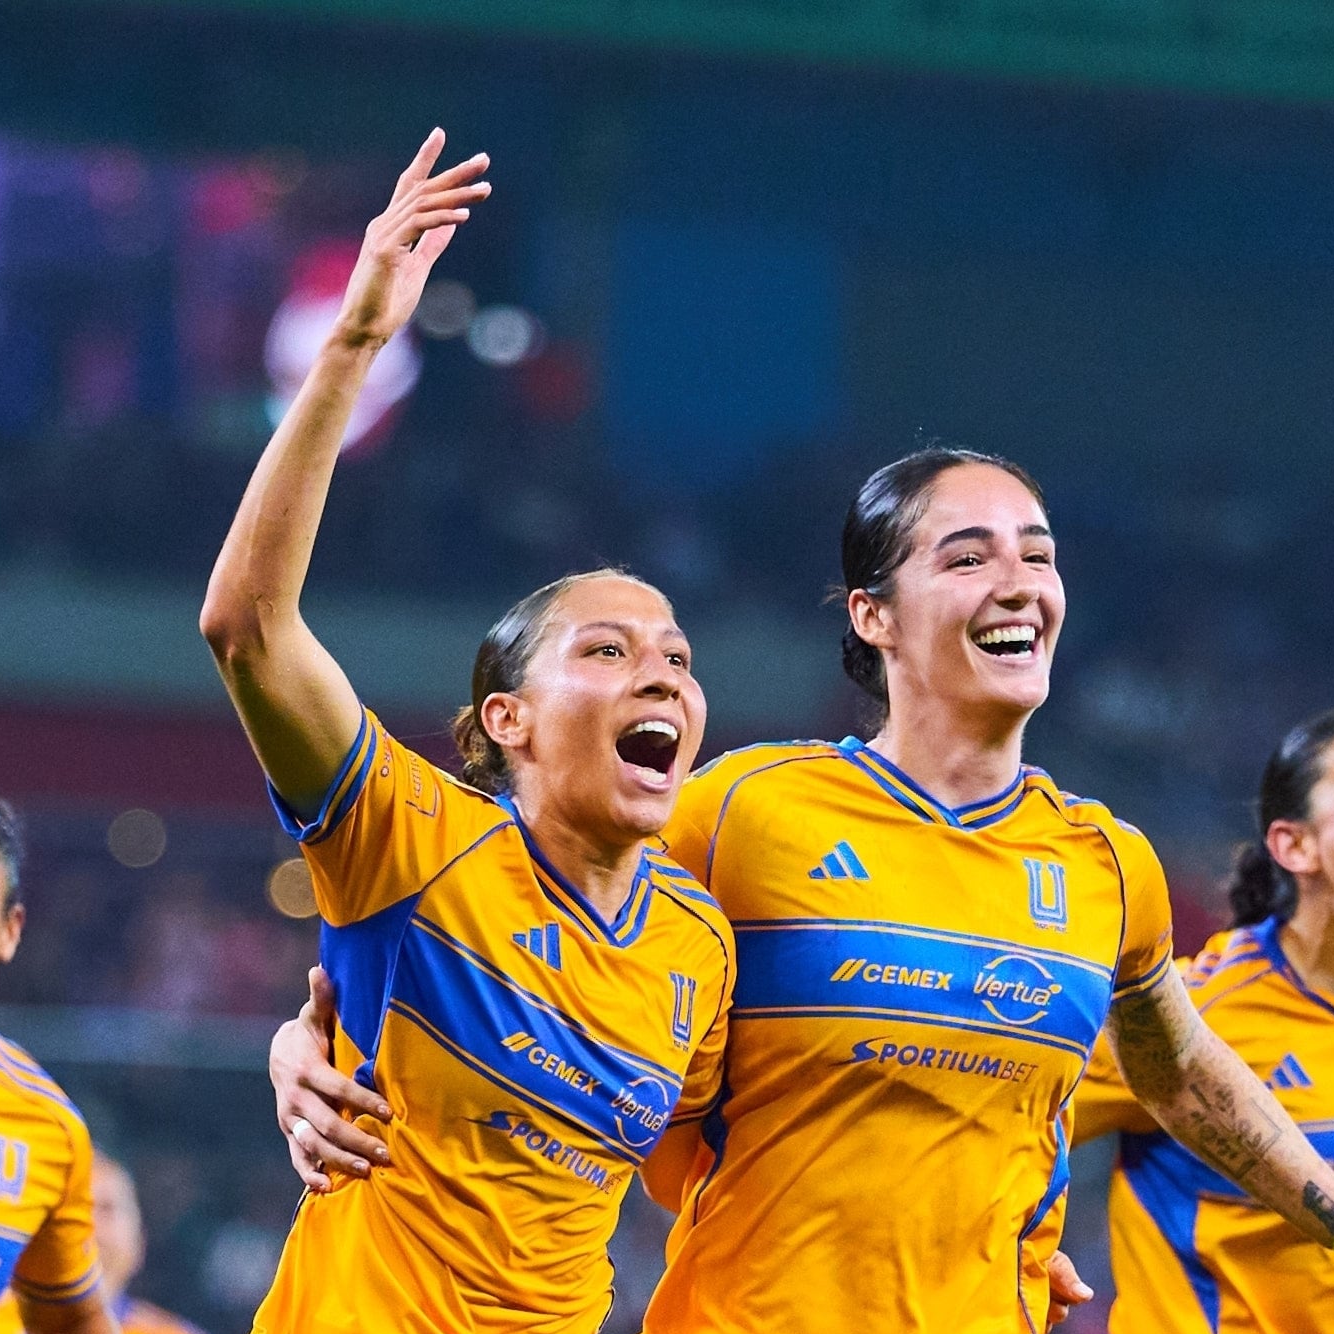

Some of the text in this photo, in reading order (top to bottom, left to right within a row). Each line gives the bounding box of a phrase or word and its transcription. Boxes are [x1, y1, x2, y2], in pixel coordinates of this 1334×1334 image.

[862, 963, 1062, 1006] CEMEX Vertua
[829, 1035, 1038, 1082] SPORTIUMBET
[528, 1047, 669, 1132] CEMEX Vertua
